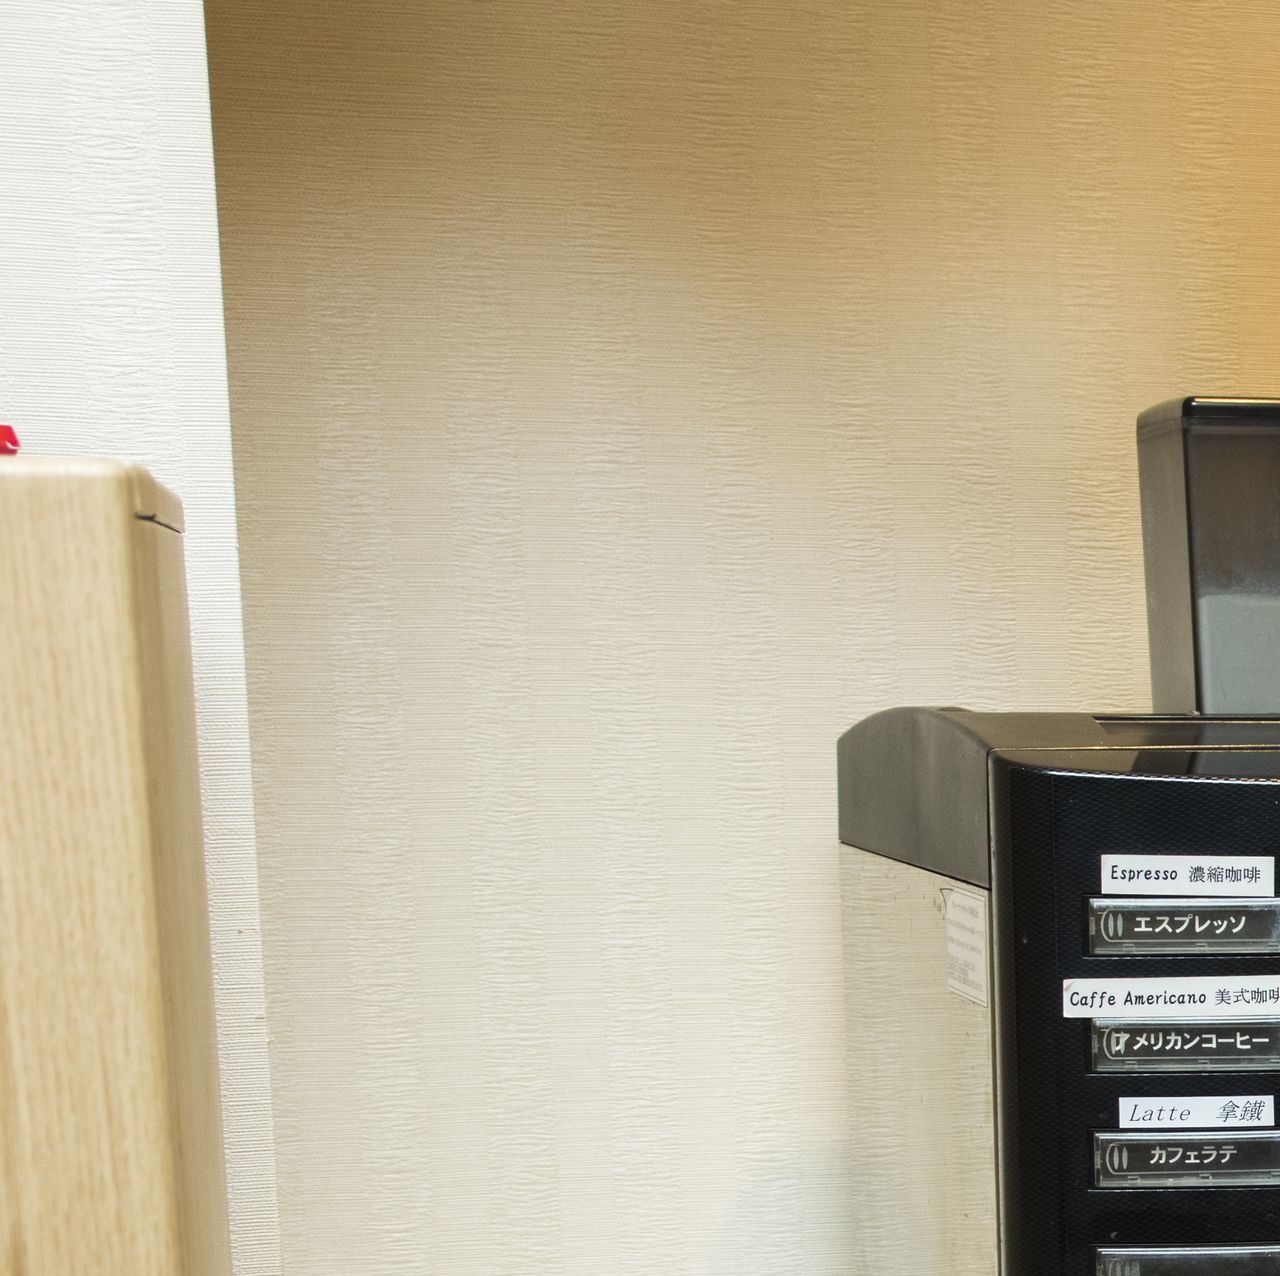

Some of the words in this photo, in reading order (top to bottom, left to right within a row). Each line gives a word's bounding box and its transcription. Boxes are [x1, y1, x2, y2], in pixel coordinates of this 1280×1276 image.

[1110, 864, 1178, 884] Espresso
[1188, 865, 1261, 884] 濃縮咖啡
[1133, 913, 1247, 934] エスプレッソ
[1069, 991, 1117, 1008] Caffe
[1123, 990, 1207, 1006] Americano
[1112, 1031, 1270, 1051] アメリカンコーヒー
[1128, 1104, 1191, 1122] Latte
[1215, 1100, 1266, 1123] 拿鐵
[1149, 1145, 1238, 1164] カフェラテ
